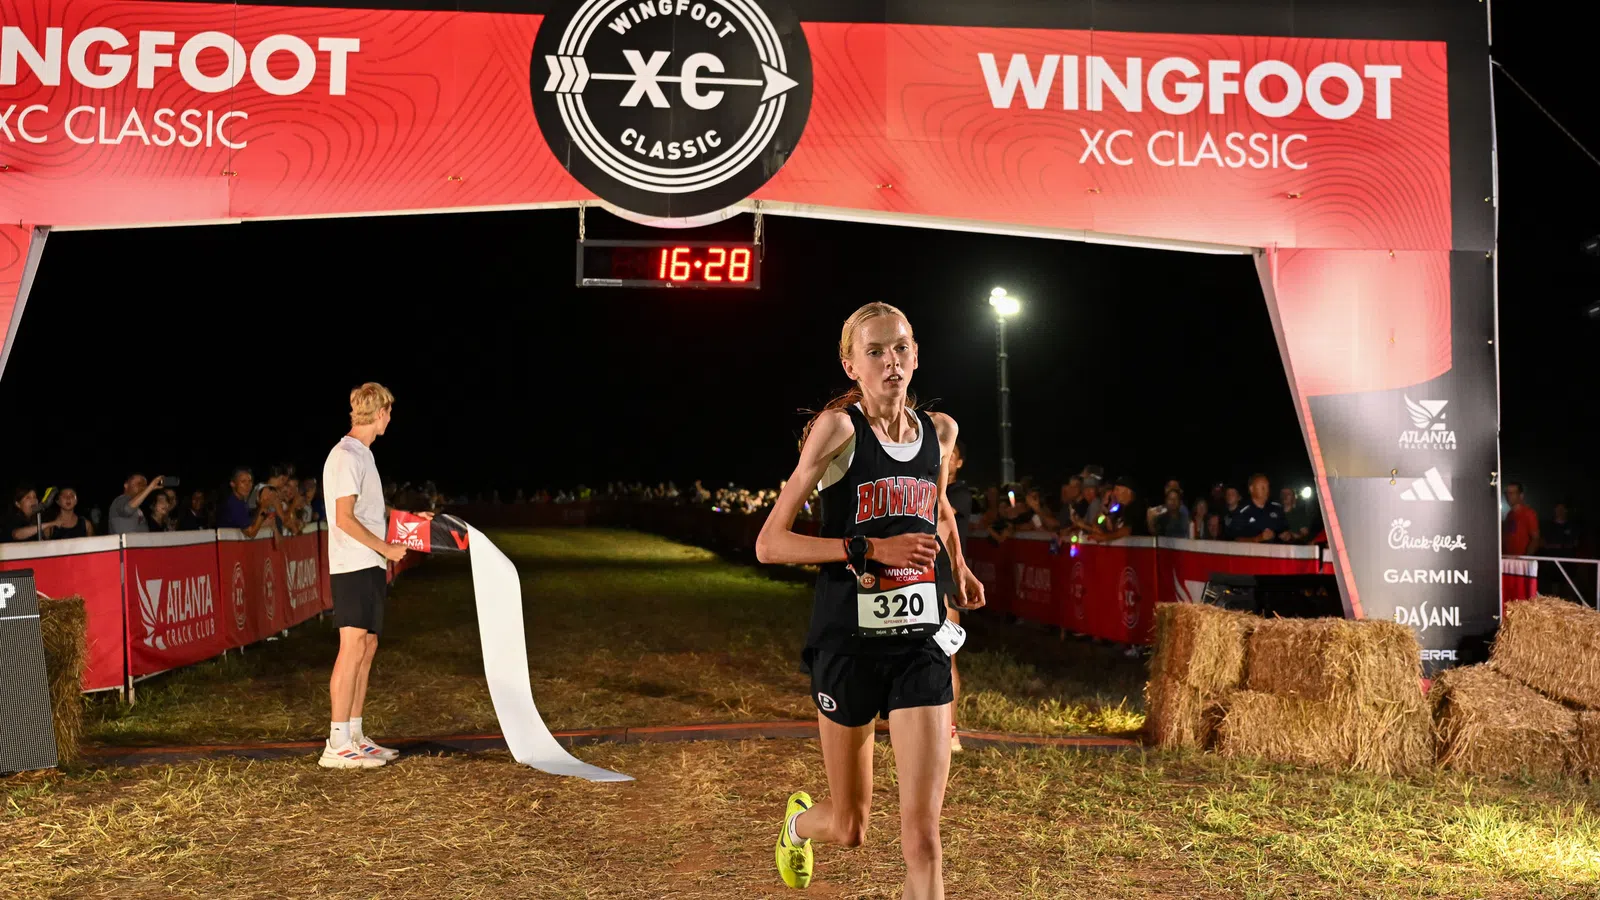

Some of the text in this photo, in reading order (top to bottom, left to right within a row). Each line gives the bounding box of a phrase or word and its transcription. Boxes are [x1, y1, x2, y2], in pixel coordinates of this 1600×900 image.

[607, 0, 737, 38] WINGFOOT
[619, 49, 726, 110] XC
[977, 52, 1403, 120] WINGFOOT
[63, 104, 249, 150] CLASSIC
[619, 127, 723, 160] CLASSIC
[1078, 128, 1309, 171] XC CLASSIC
[1398, 430, 1457, 444] ATLANTA
[855, 476, 938, 525] BOWDON
[1387, 517, 1468, 553] Chick-fil-A
[1383, 568, 1469, 585] GARMIN
[166, 573, 214, 625] ATLANTA
[873, 592, 924, 619] 320
[1394, 600, 1461, 632] DASANI
[165, 617, 216, 647] TRACK CLUB
